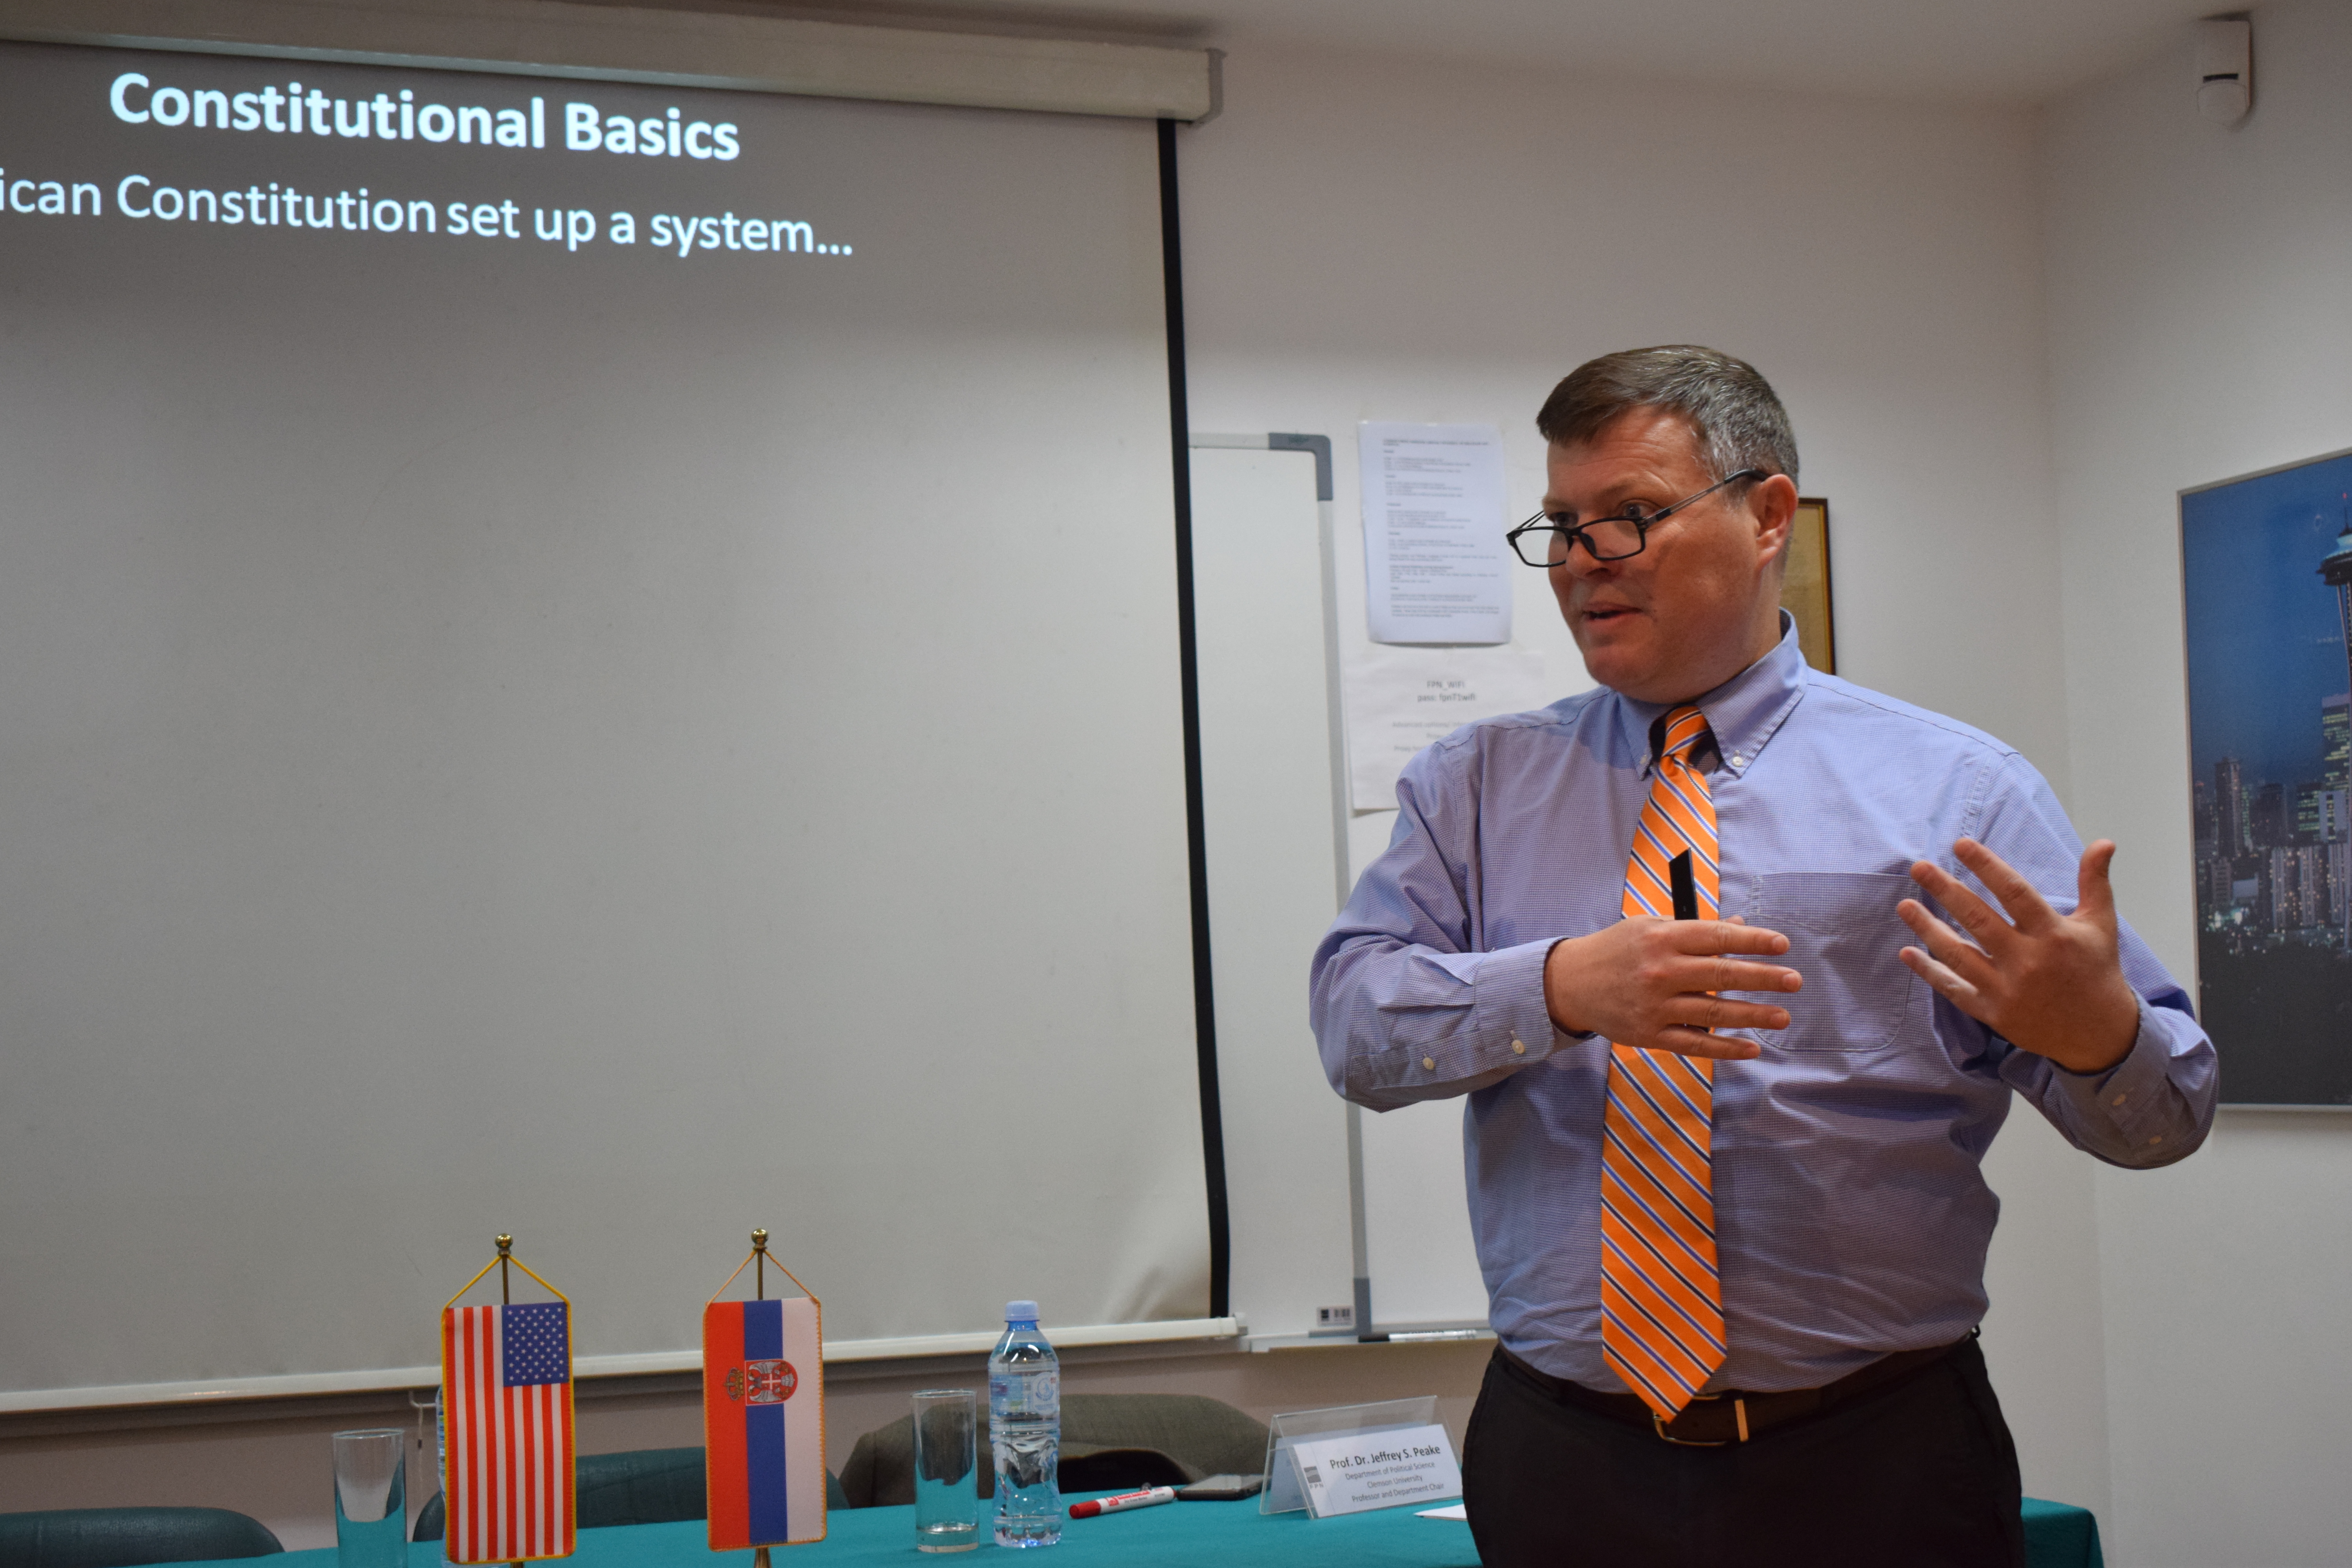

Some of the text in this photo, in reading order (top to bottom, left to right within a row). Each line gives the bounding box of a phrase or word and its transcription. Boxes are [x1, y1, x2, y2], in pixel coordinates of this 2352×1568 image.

[110, 73, 740, 161] Constitutional Basics
[117, 175, 436, 233] Constitution
[447, 200, 521, 239] set
[535, 208, 596, 252] up
[610, 212, 636, 244] a
[651, 211, 853, 258] system...
[1330, 1445, 1440, 1469] Prof. Dr. Jeffrey S. Peake
[1345, 1469, 1382, 1480] Department
[1390, 1464, 1413, 1473] Political
[1414, 1461, 1435, 1470] Science
[1367, 1474, 1423, 1488] Clemson University
[1352, 1492, 1380, 1503] Professor
[1393, 1485, 1428, 1497] Department
